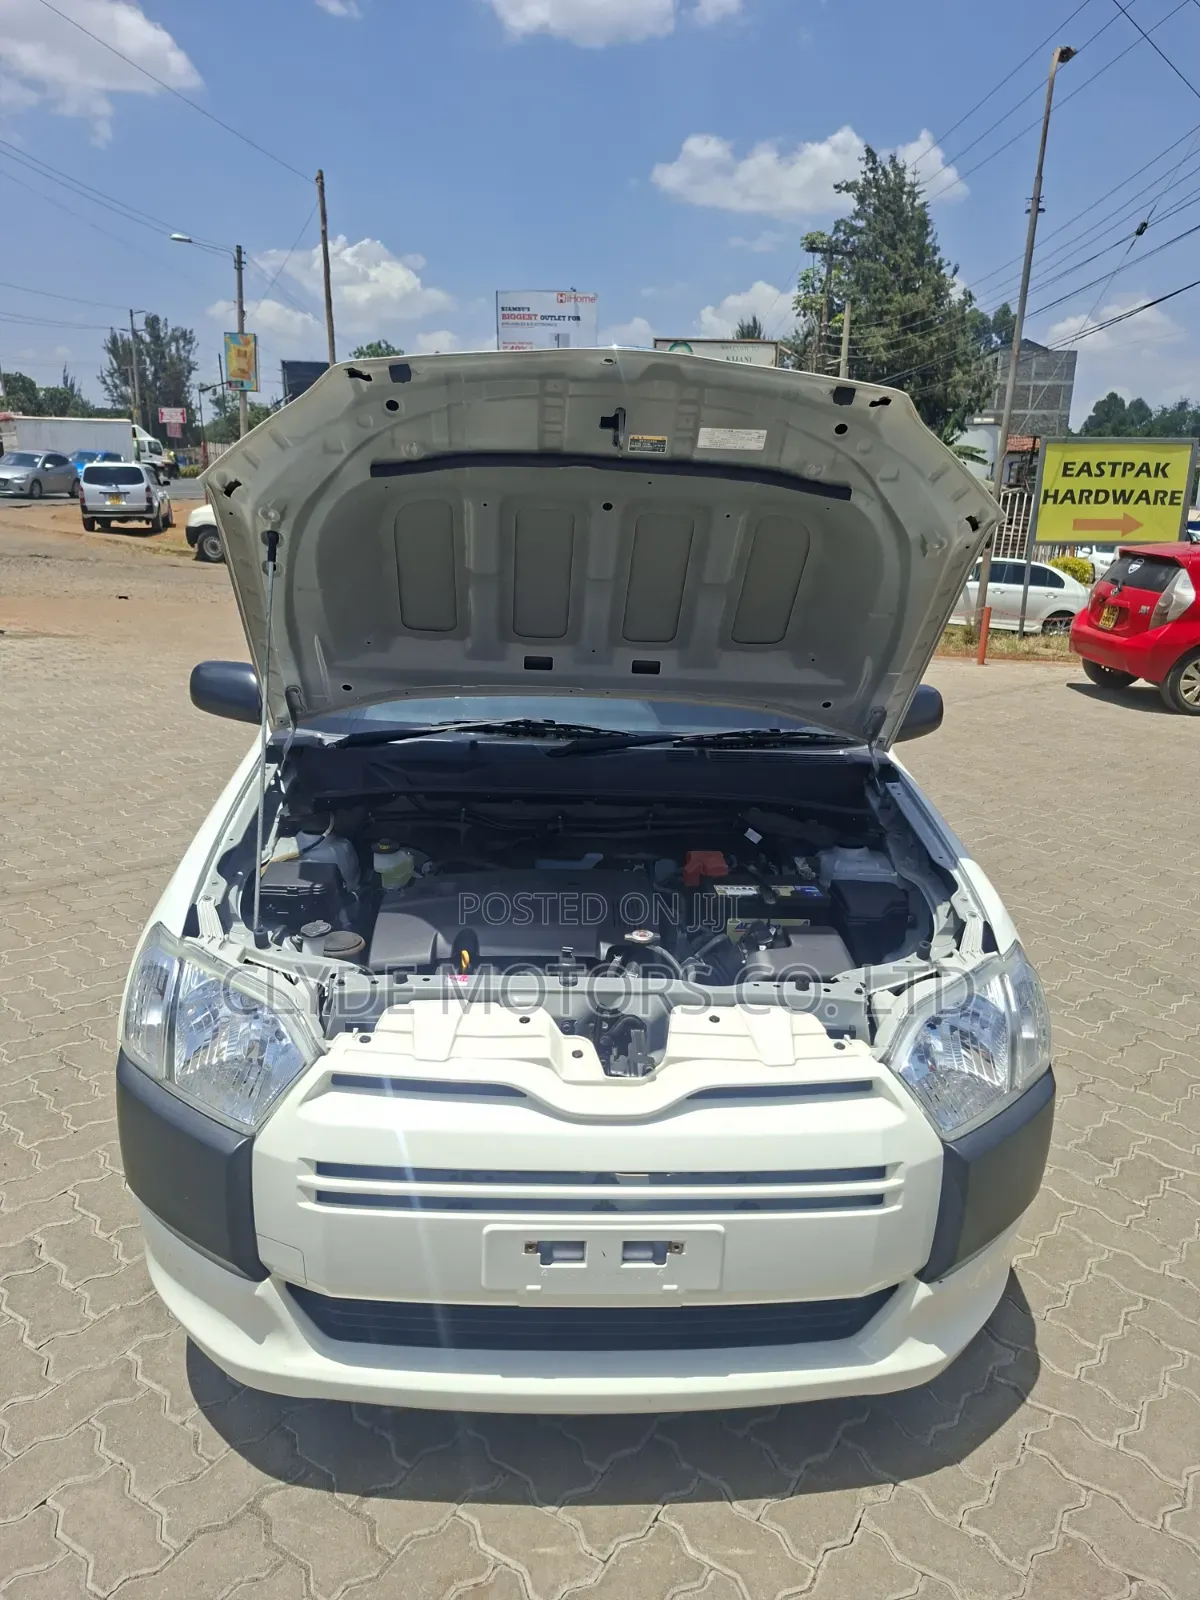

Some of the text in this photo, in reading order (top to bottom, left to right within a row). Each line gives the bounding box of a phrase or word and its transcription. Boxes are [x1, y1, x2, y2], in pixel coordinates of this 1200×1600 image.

[501, 313, 538, 321] BIGGEST
[1061, 461, 1171, 478] EASTPAK
[1042, 488, 1183, 505] HARDWARE
